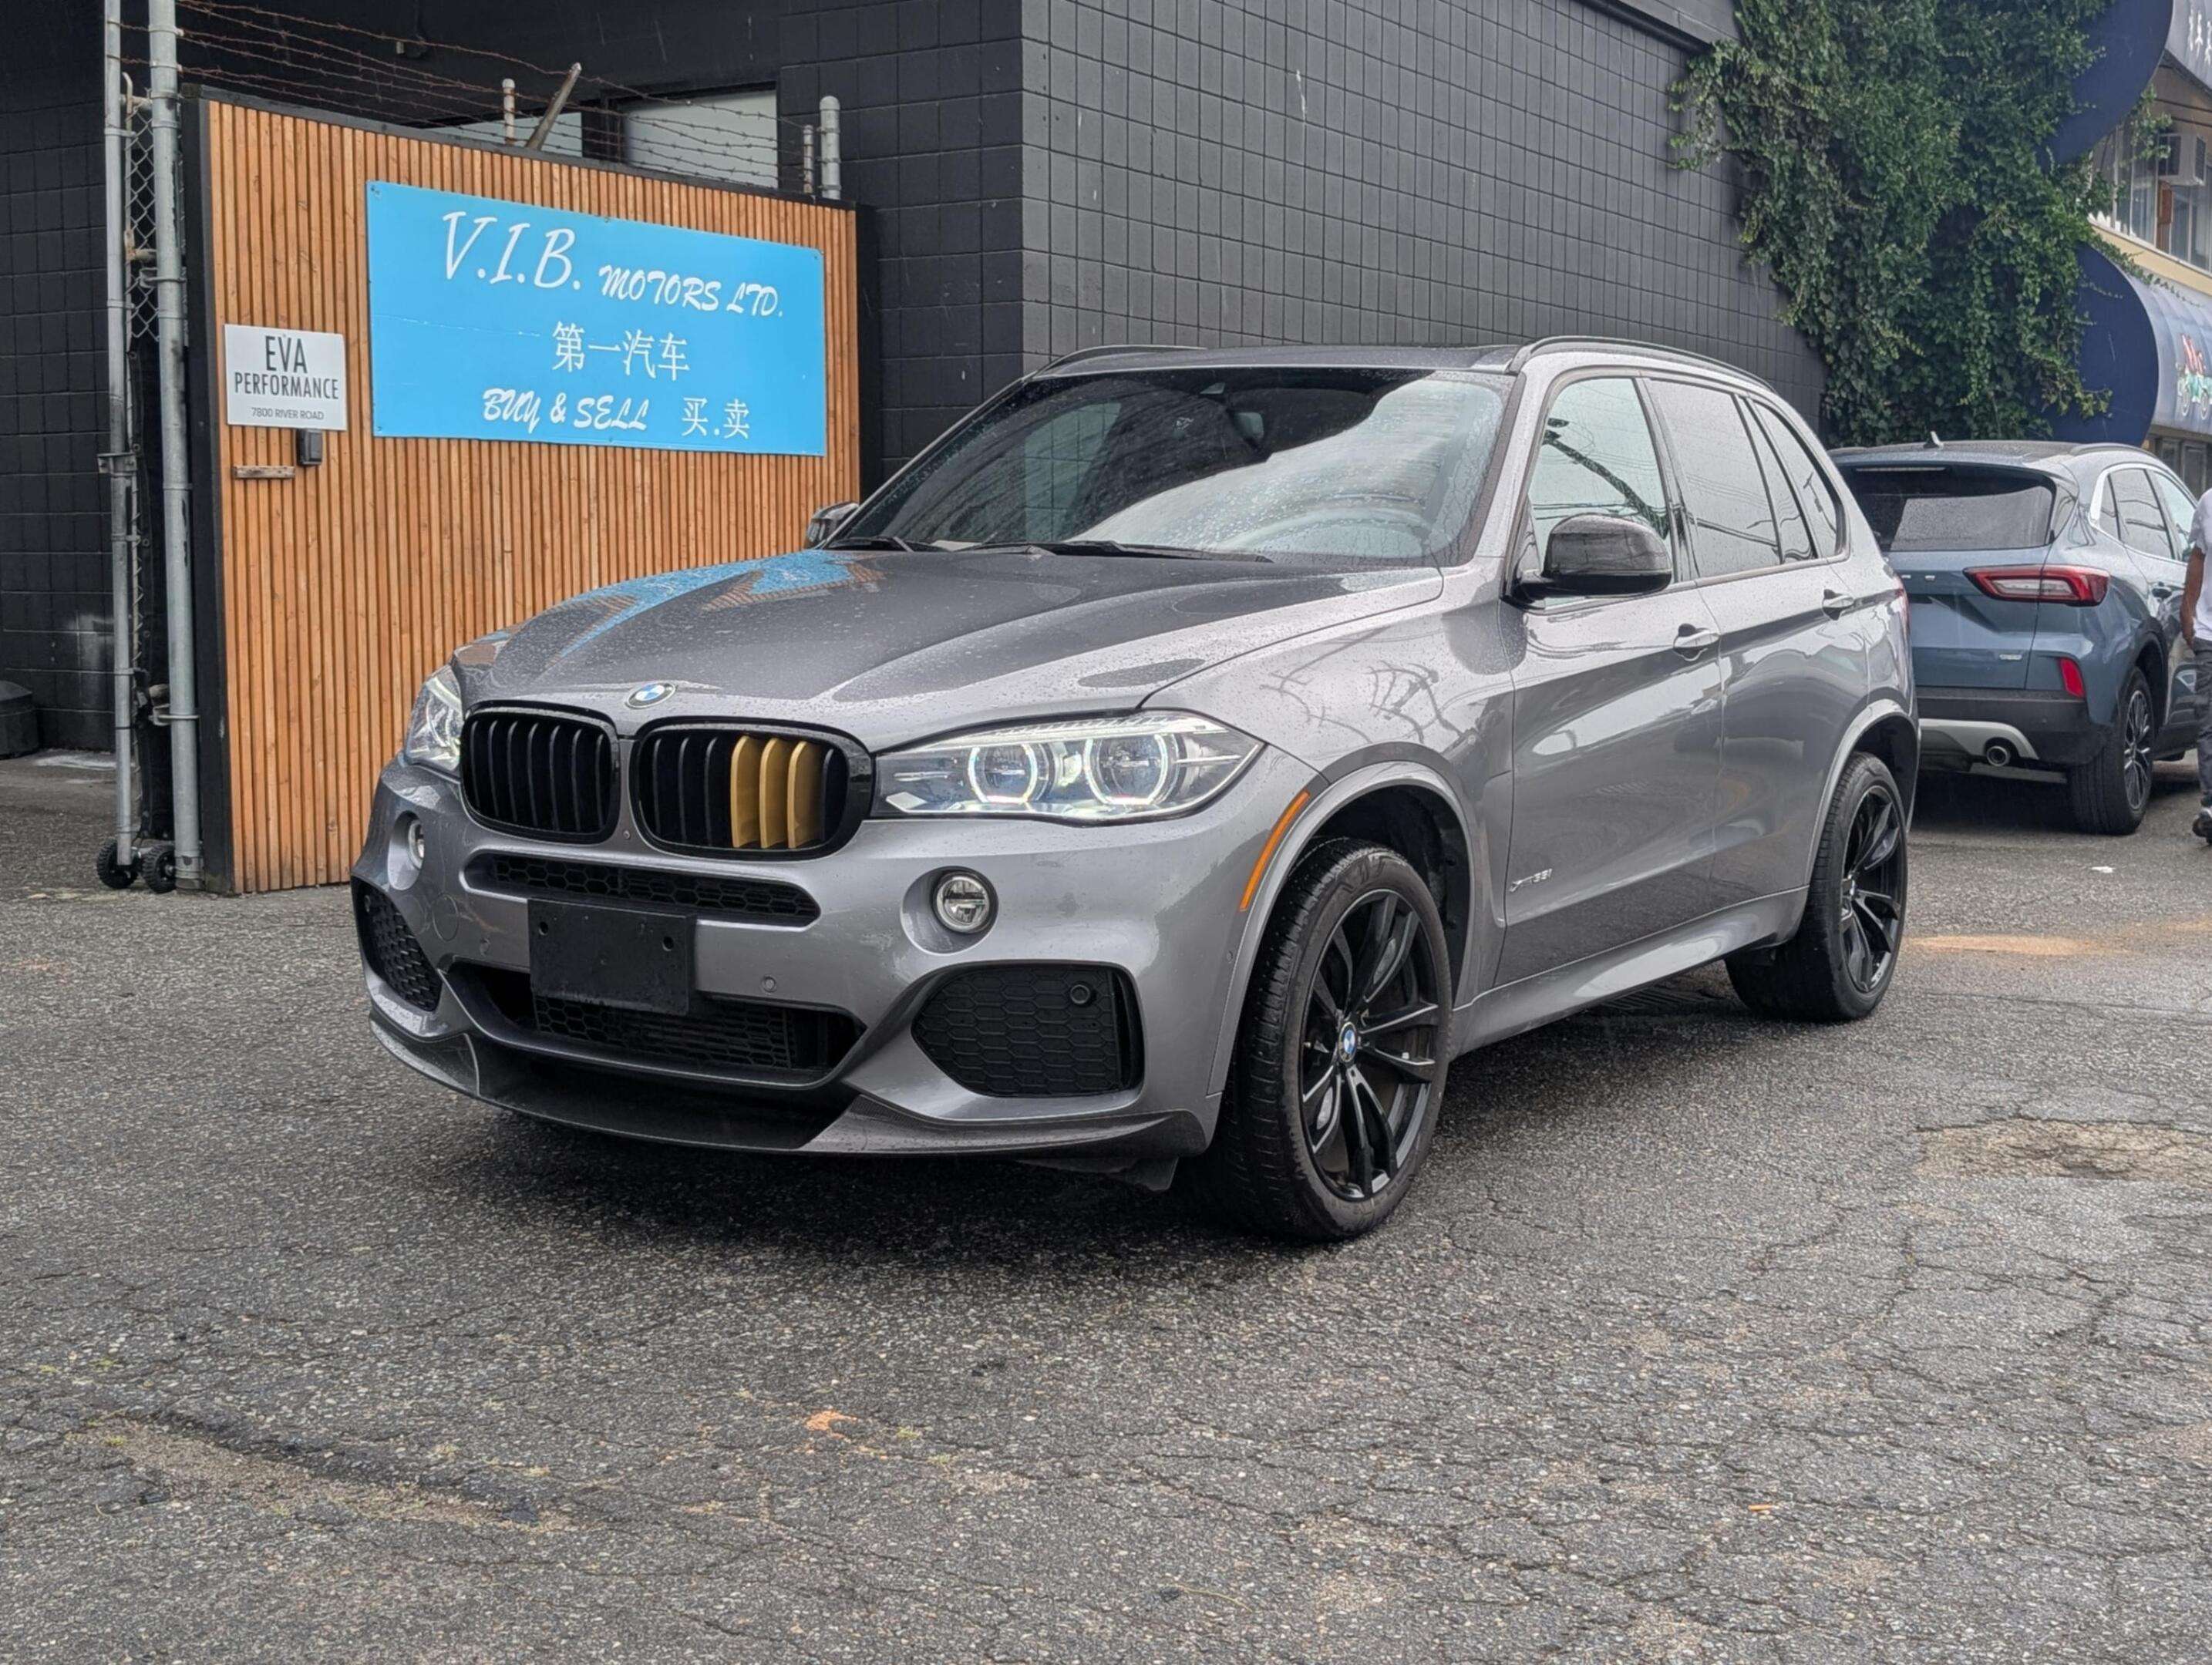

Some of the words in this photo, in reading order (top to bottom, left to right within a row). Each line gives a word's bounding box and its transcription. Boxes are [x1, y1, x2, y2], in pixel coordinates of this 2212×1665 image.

[442, 210, 581, 291] V.I.B.
[598, 264, 722, 311] MOTORS
[726, 281, 783, 318] LTD.
[265, 335, 308, 373] EVA
[551, 320, 691, 382] 第一汽车
[234, 372, 338, 399] PERFORMANCE
[252, 407, 273, 417] 7800
[275, 409, 298, 419] RIVER
[300, 410, 324, 420] ROAD
[482, 388, 541, 434] BUY
[549, 392, 567, 424] &
[573, 395, 650, 432] SELL
